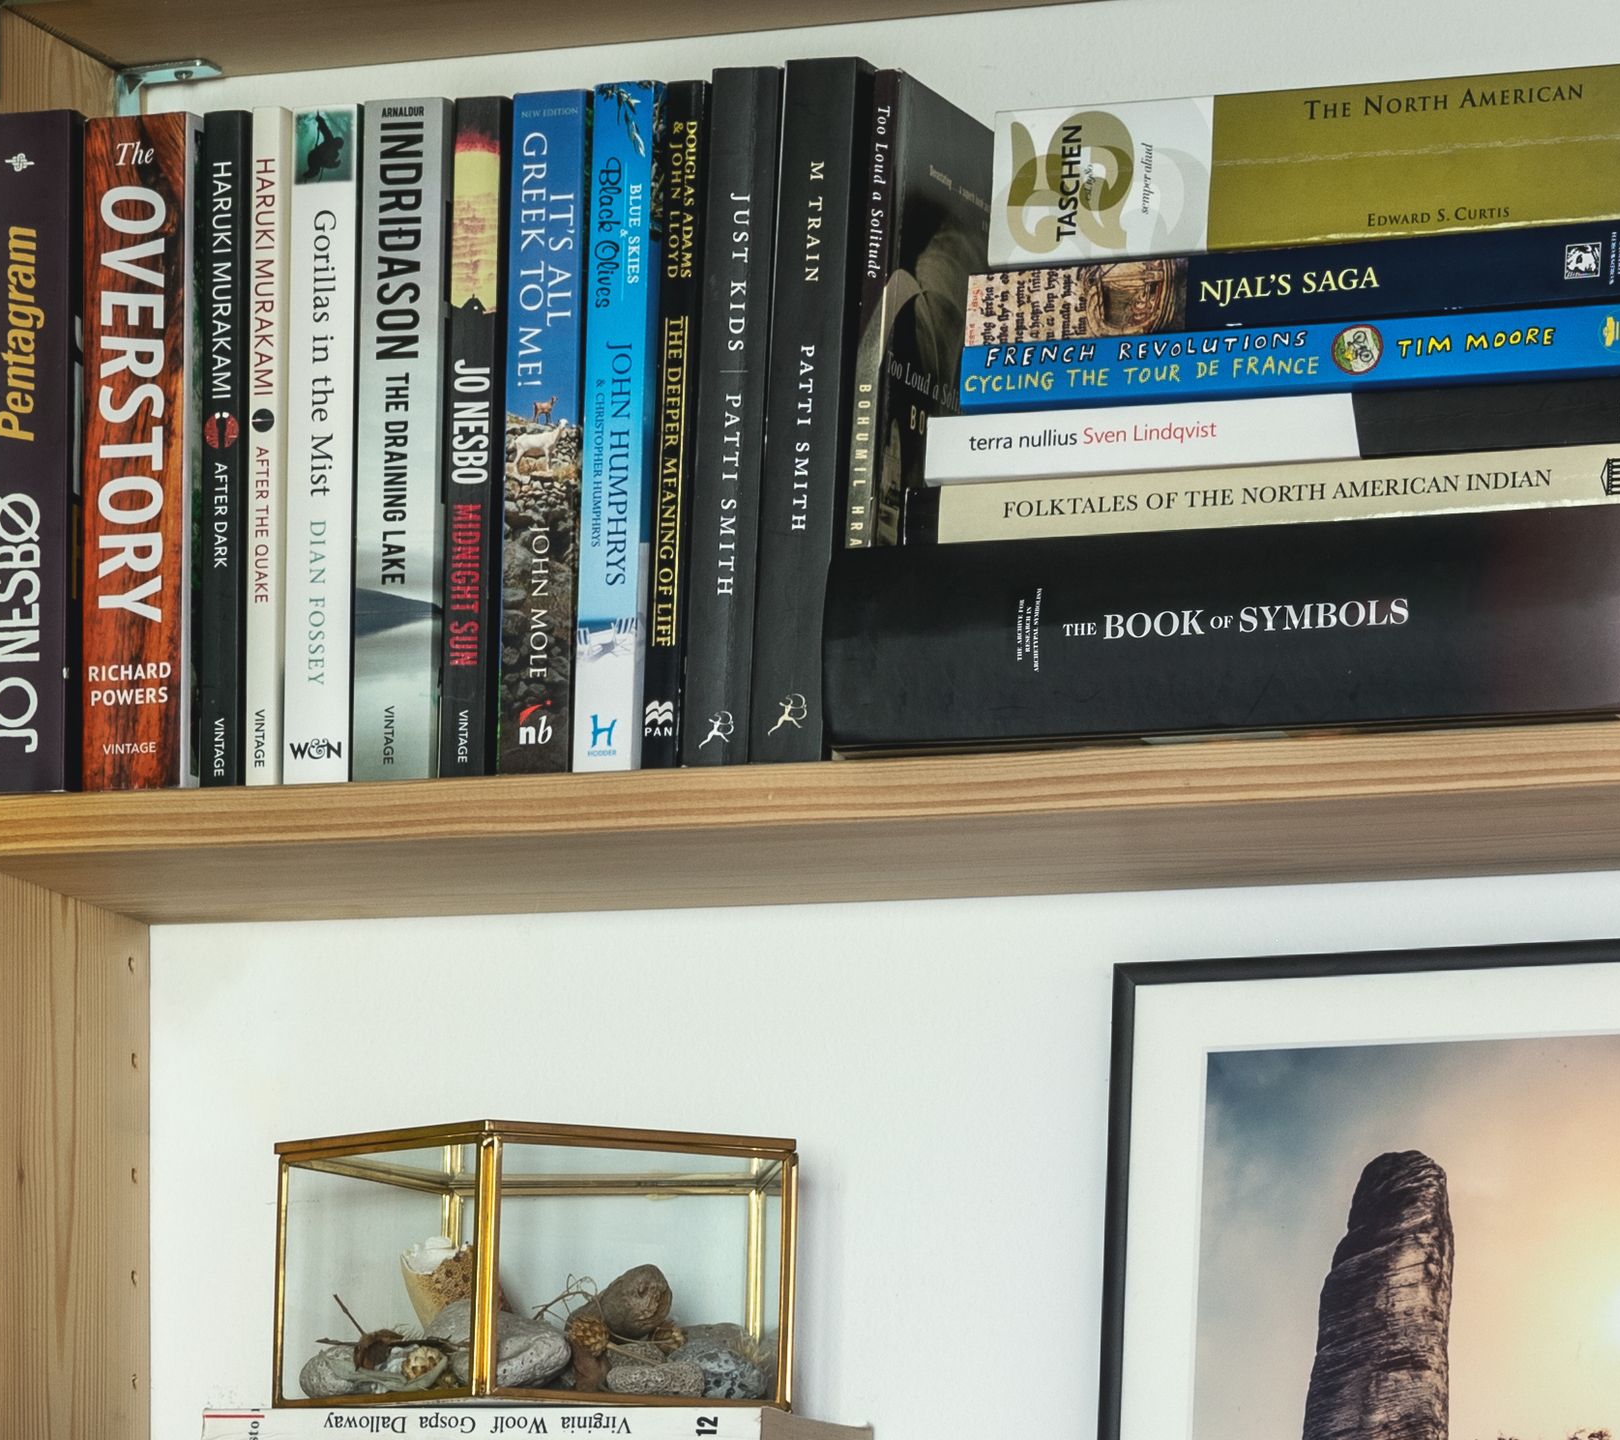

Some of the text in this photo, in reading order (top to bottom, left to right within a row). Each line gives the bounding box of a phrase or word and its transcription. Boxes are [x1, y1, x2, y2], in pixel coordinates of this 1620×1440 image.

[115, 141, 154, 166] The
[517, 133, 547, 389] GREEK TO ME!
[547, 193, 574, 327] IT'S ALL
[727, 193, 751, 352] JUST KIDS
[97, 185, 167, 623] OVERSTORY
[309, 210, 337, 498] Gorillas in the Mist
[452, 360, 490, 485] JO NESBO
[969, 420, 1218, 451] terra nullius Sven Lindqvist
[1003, 468, 1552, 518] FOLKTALES OF THE NORTH AMERICAN INDIAN
[449, 503, 482, 667] MIDNIGHT SUN
[1062, 621, 1098, 638] THE
[1102, 608, 1205, 639] BOOK
[1238, 597, 1410, 633] SYMBOLS
[88, 662, 171, 682] RICHARD
[90, 687, 168, 706] POWERS
